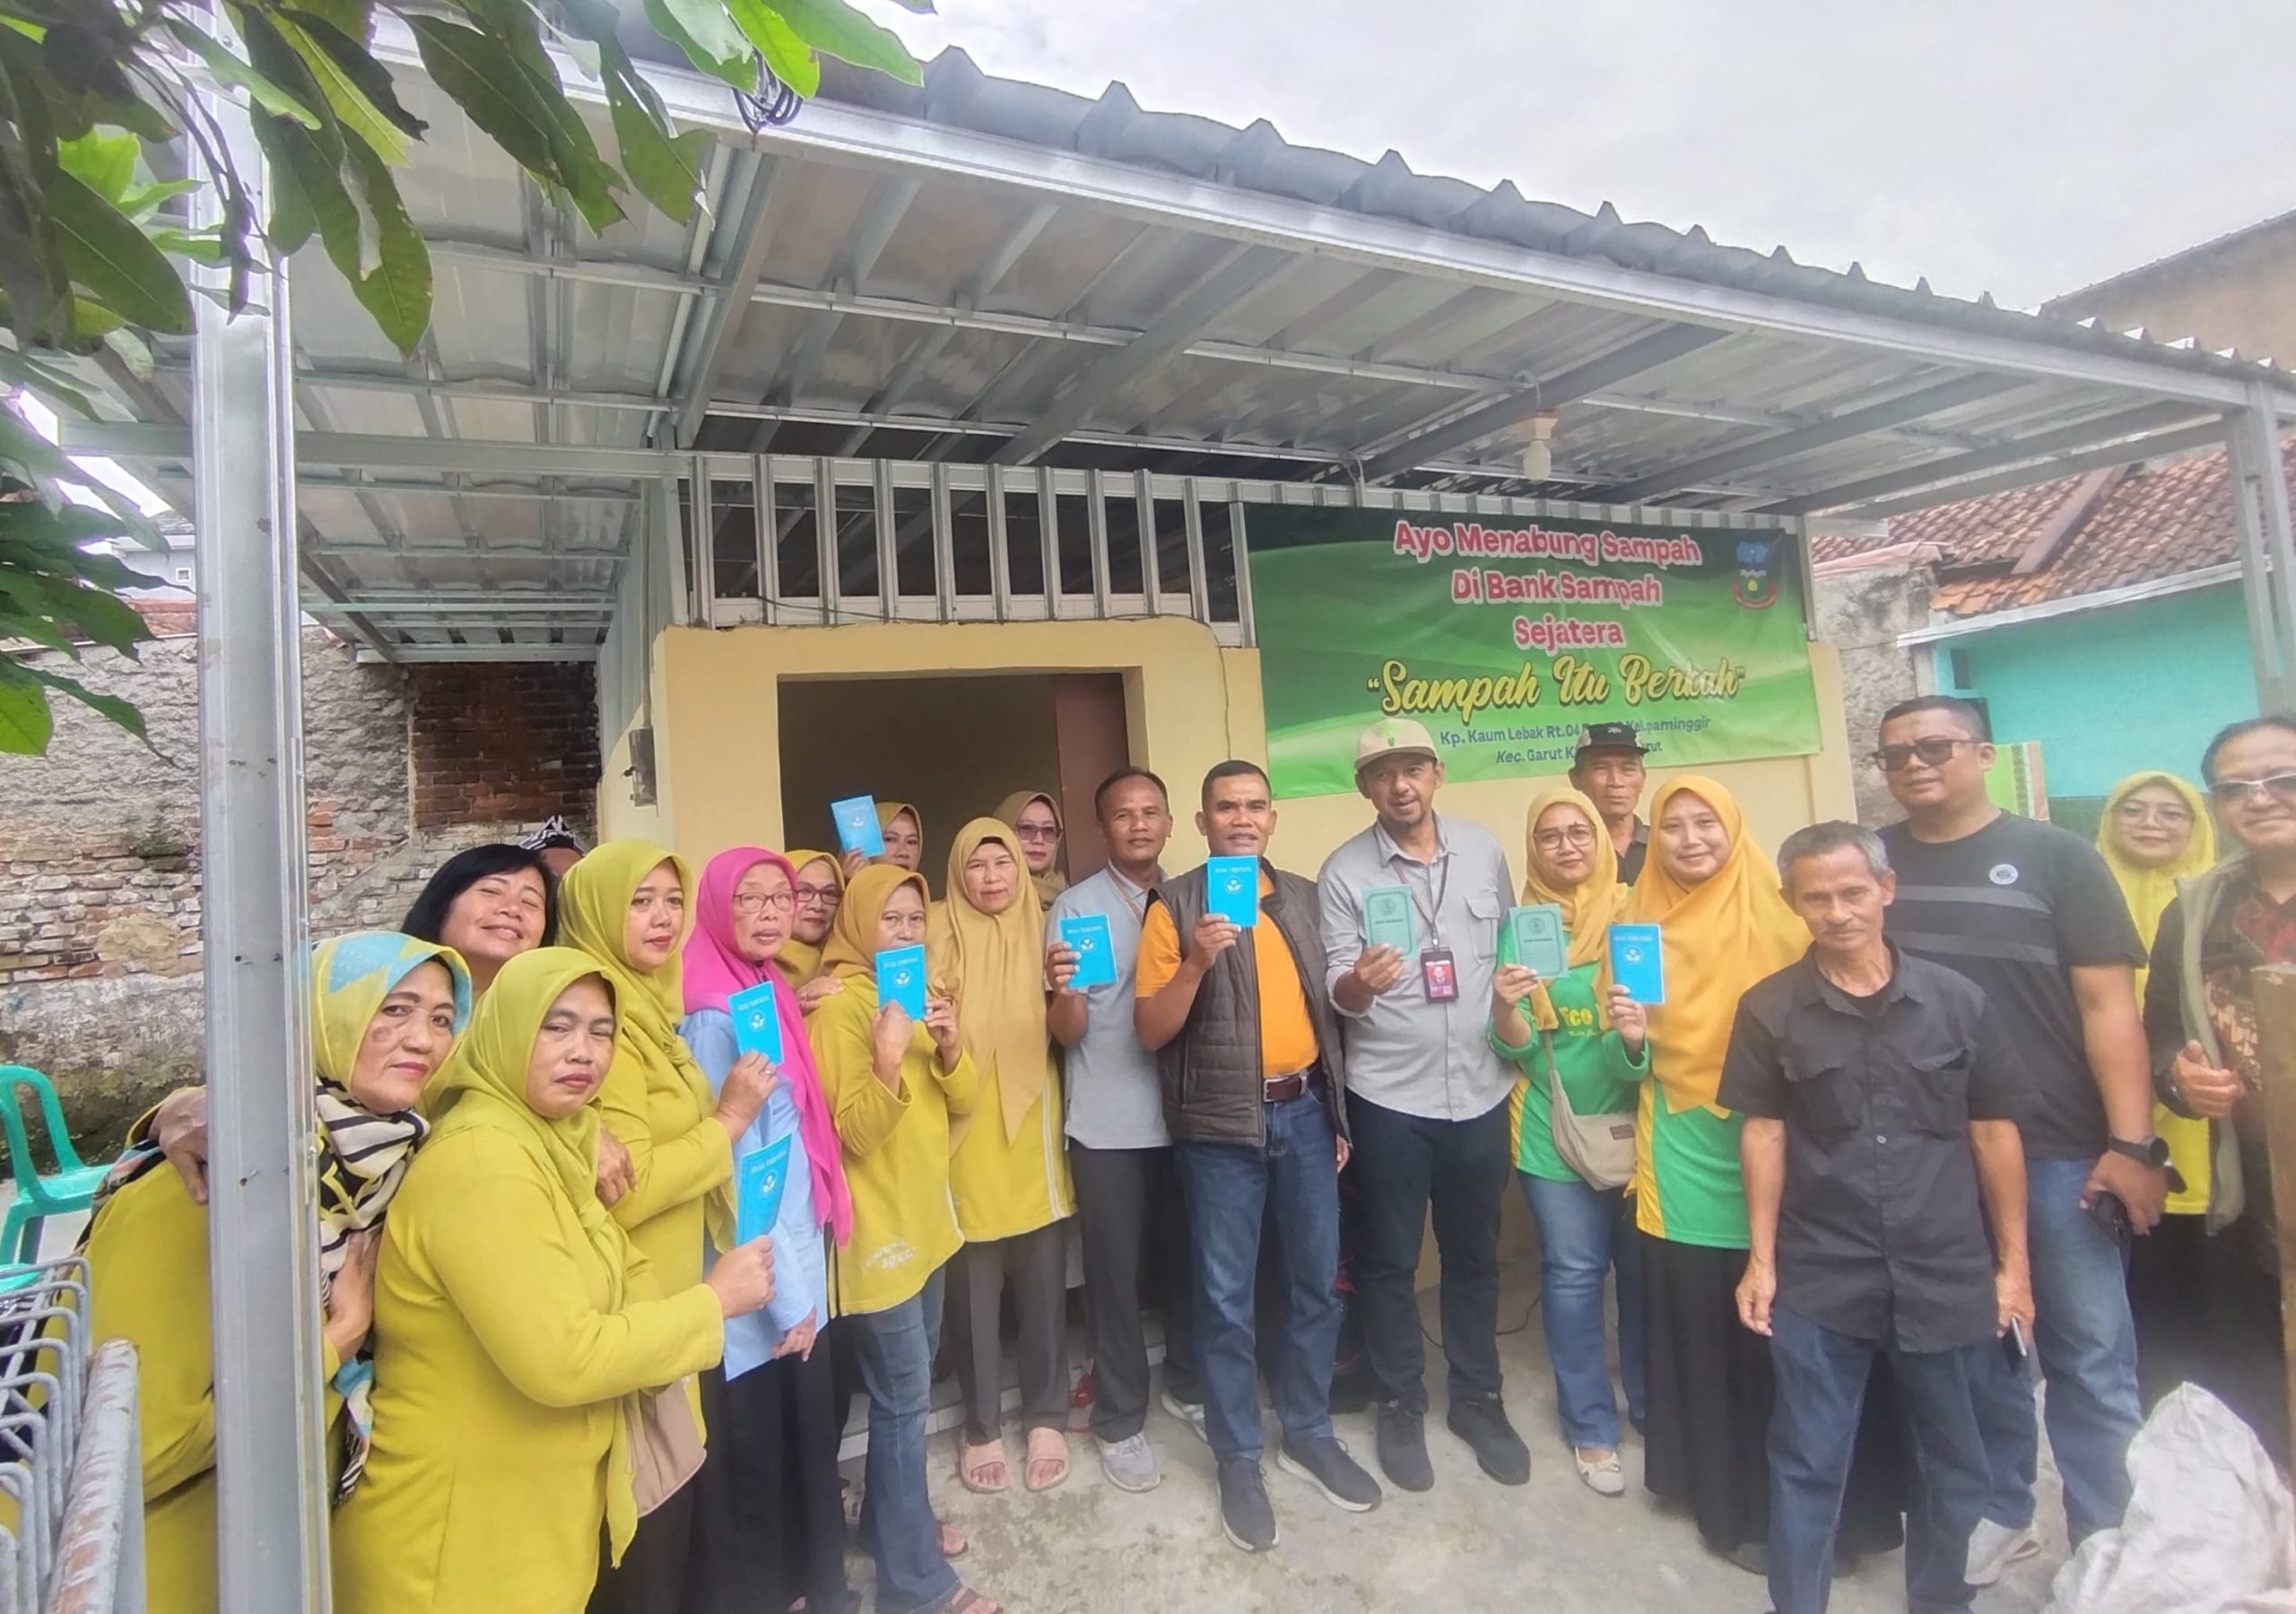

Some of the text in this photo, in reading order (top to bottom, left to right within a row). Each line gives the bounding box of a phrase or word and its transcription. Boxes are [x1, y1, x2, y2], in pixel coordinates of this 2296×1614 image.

[1393, 520, 1702, 570] Ayo Menabung Sampah
[1451, 567, 1663, 610] Di Bank Sampah
[1513, 612, 1626, 656] Sejatera
[1552, 655, 1611, 707] Itu
[1439, 731, 1465, 748] Kp.
[1467, 729, 1506, 744] Kaum
[1508, 726, 1544, 742] Lebak
[1496, 750, 1525, 764] Kec.
[1526, 747, 1563, 762] Garut
